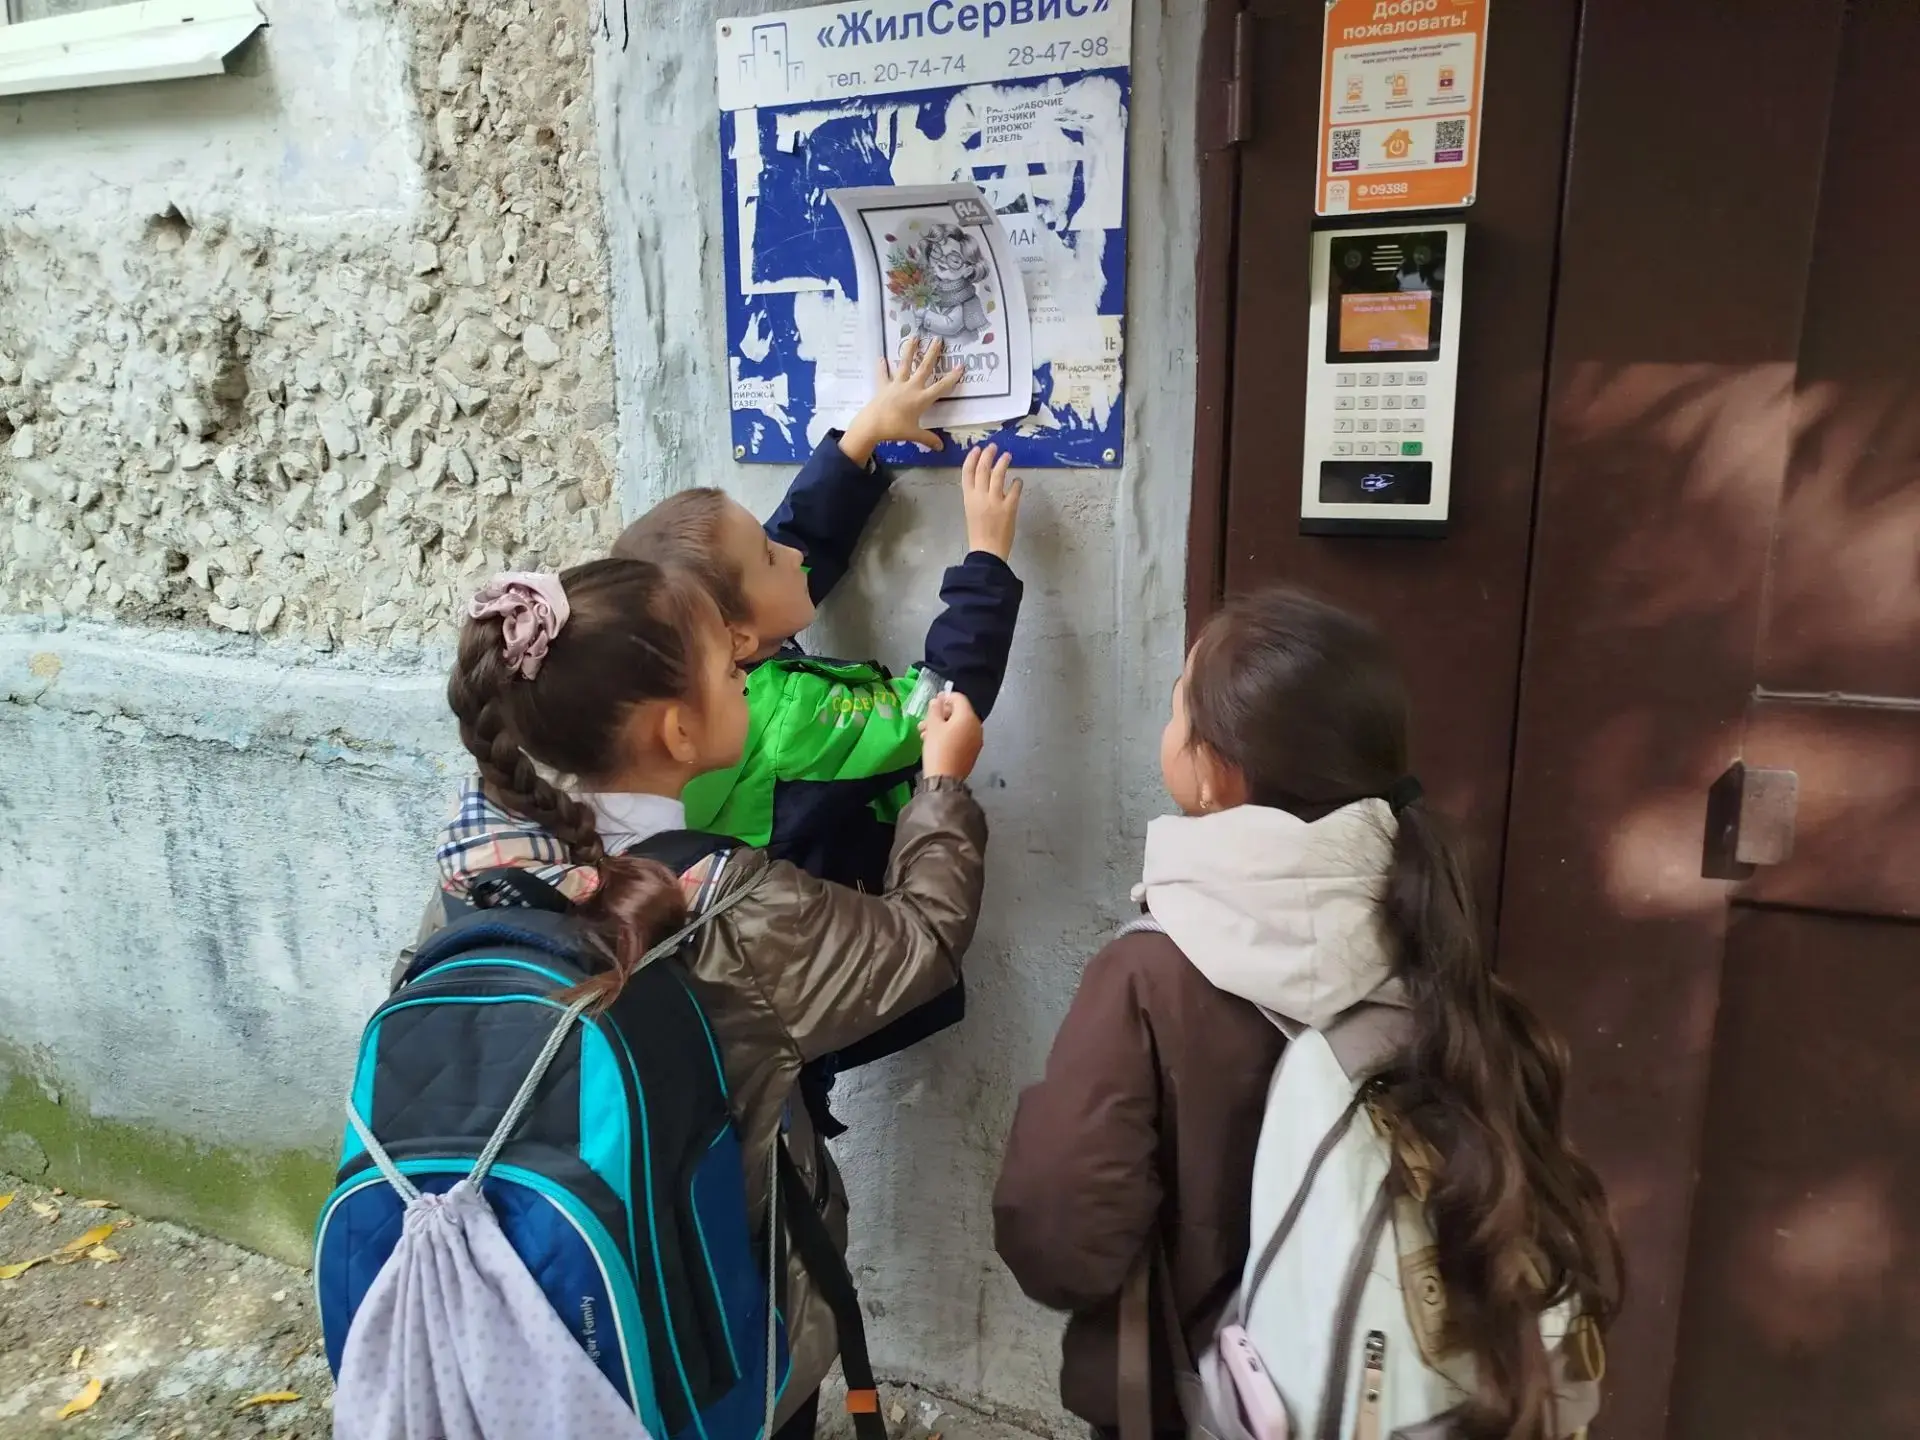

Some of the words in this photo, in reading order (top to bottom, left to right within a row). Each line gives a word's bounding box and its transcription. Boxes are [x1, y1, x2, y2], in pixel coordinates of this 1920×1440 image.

[1372, 0, 1438, 20] Добро
[817, 0, 1109, 48] «ЖилСервис»
[1343, 11, 1467, 40] пожаловать!
[827, 71, 866, 88] тел.
[874, 54, 966, 83] 20-74-74
[1008, 36, 1108, 67] 28-47-98
[987, 111, 1036, 124] ГРУЗЧИКИ
[986, 134, 1023, 144] ГАЗЕЛЬ
[1369, 182, 1408, 195] 09388
